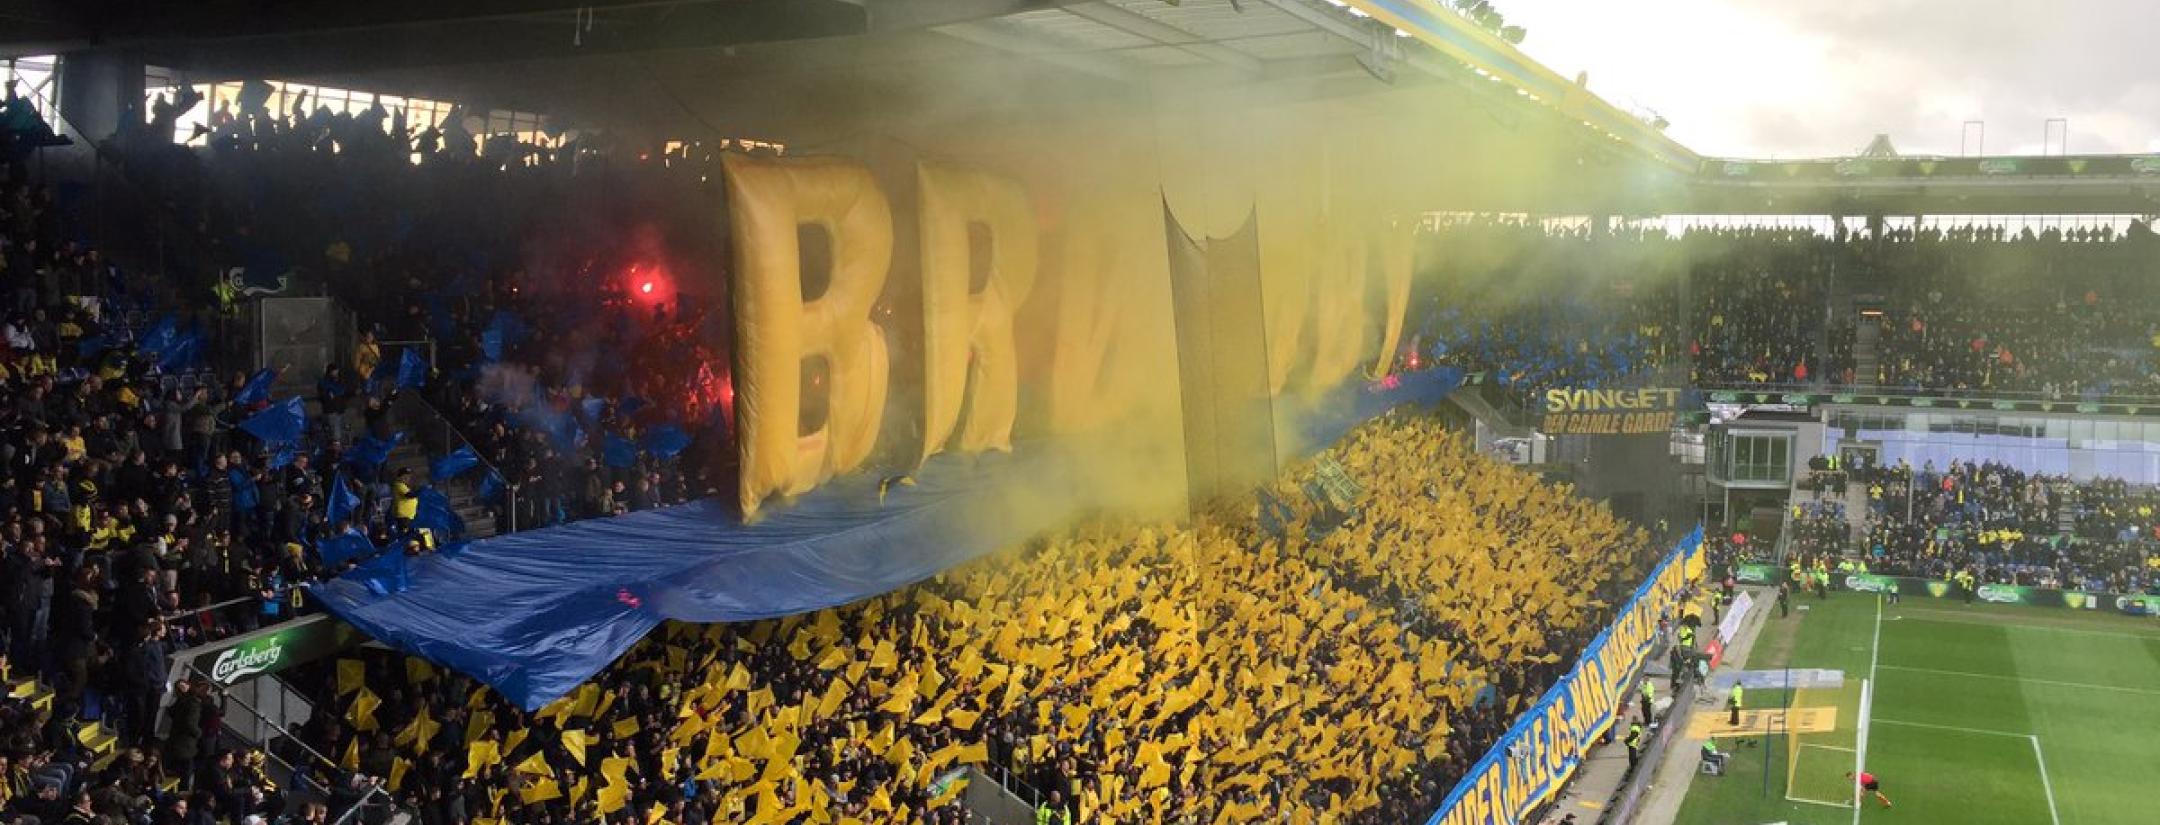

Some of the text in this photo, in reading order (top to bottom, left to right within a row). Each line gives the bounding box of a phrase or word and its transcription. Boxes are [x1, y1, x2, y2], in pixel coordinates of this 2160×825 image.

[1546, 385, 1681, 412] SVINGET
[1567, 412, 1620, 434] GAMLE
[212, 637, 283, 684] Carlsberg
